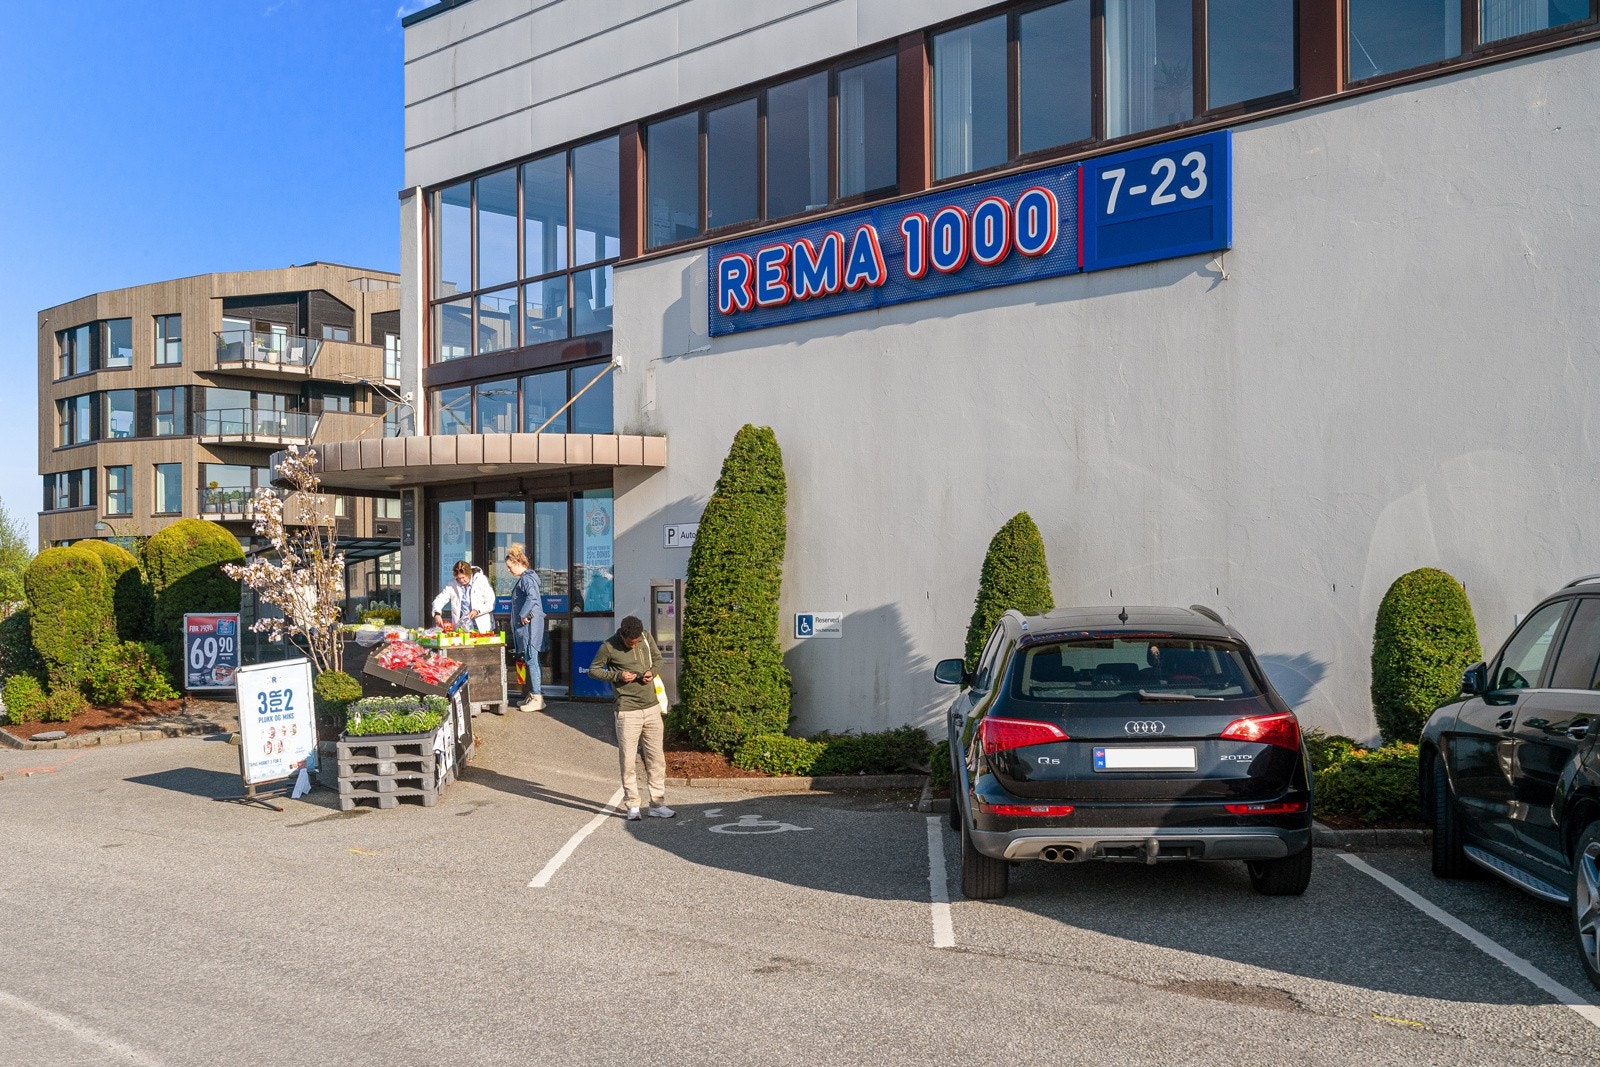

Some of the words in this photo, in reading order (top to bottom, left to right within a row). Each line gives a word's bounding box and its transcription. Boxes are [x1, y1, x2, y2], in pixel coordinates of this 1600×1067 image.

[1102, 151, 1208, 215] 7-23
[717, 223, 887, 316] REMA
[900, 186, 1060, 280] 1000
[668, 528, 675, 544] P
[191, 637, 217, 669] 69
[218, 637, 233, 653] 90
[257, 691, 268, 715] 3
[269, 689, 282, 713] FOR
[283, 688, 294, 711] 2
[258, 715, 273, 724] PLUKK
[1037, 756, 1060, 765] Q5
